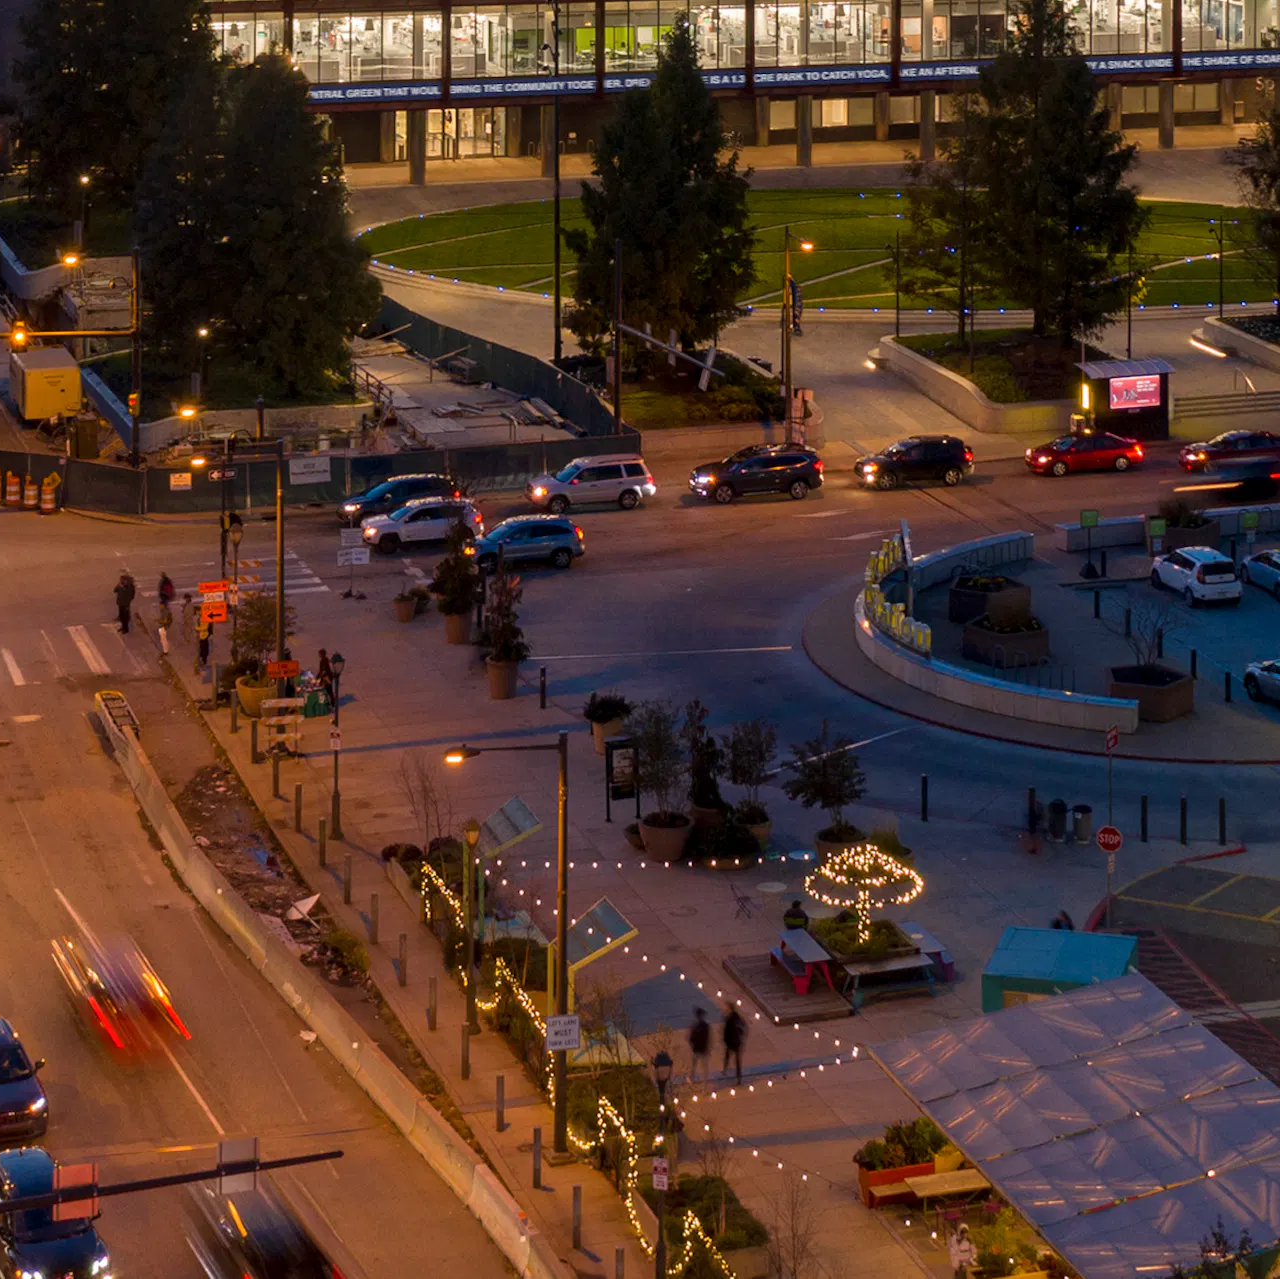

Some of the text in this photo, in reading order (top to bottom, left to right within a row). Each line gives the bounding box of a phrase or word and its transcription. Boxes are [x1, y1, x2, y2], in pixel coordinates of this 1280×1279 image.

[346, 88, 382, 98] GREEN
[383, 87, 409, 97] THAT
[410, 86, 441, 95] WOUL
[449, 84, 482, 94] BRING
[483, 83, 504, 93] THE
[505, 81, 565, 92] COMMUNITY
[710, 75, 721, 84] IS
[721, 75, 730, 84] A
[753, 73, 775, 82] CRE
[776, 72, 805, 81] PARK
[806, 72, 819, 81] TO
[822, 71, 855, 80] CATCH
[918, 67, 933, 76] AN
[1099, 61, 1107, 69] A
[1107, 59, 1143, 69] SNACK
[1144, 58, 1173, 68] UNDE
[1182, 57, 1202, 67] THE
[1204, 55, 1239, 66] SHADE
[1241, 55, 1254, 65] OF
[1099, 833, 1121, 845] STOP
